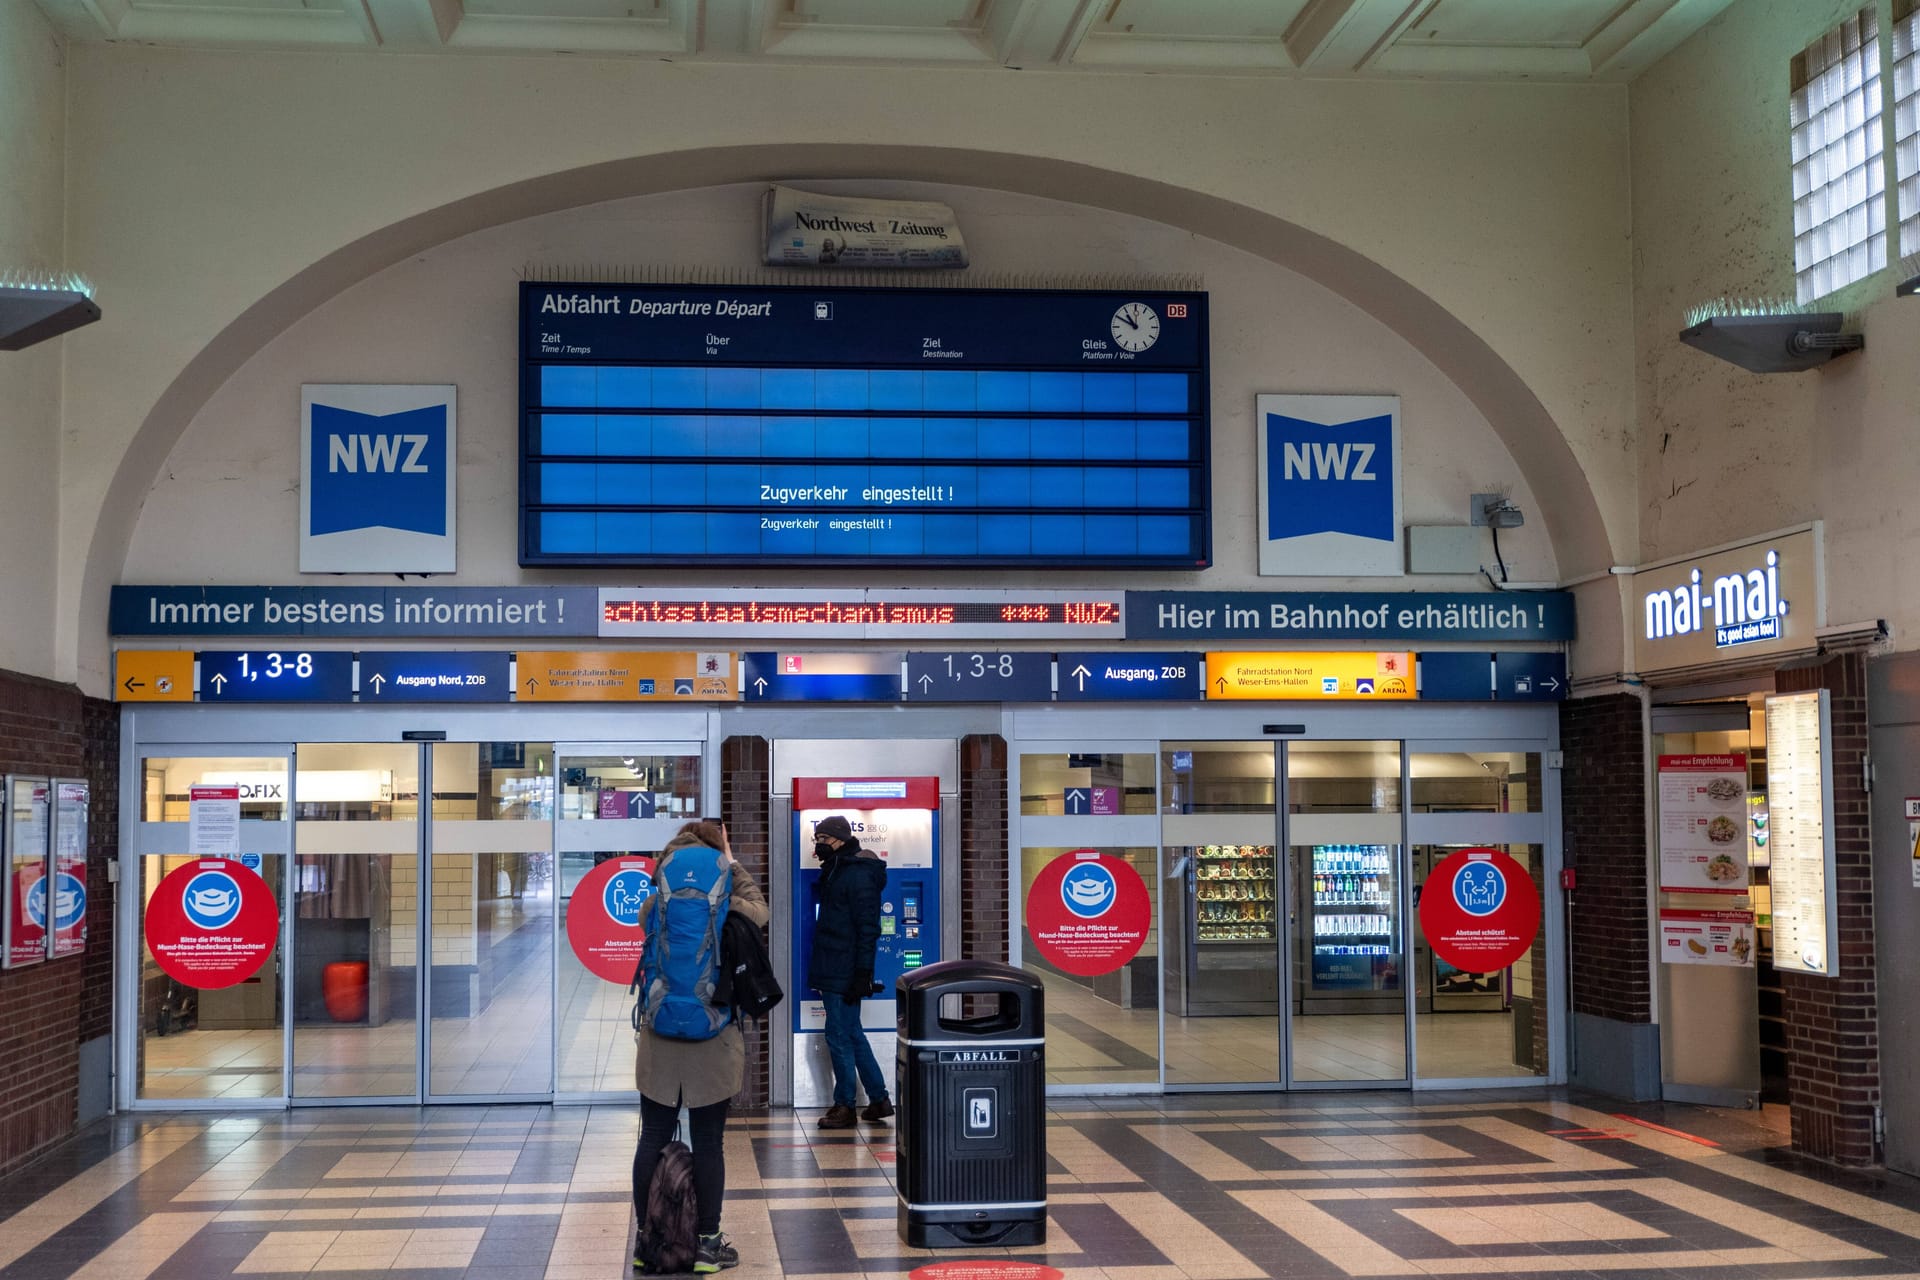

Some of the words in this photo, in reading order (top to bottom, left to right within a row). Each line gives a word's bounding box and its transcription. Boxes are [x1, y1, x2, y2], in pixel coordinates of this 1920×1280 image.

[795, 210, 877, 234] Nordwest
[888, 220, 948, 240] Zeitung
[541, 294, 621, 315] Abfahrt
[629, 298, 712, 318] Departure
[715, 300, 772, 319] Départ
[1168, 305, 1186, 317] DB
[541, 333, 561, 343] Zeit
[706, 334, 730, 346] Über
[923, 338, 941, 348] Ziel
[541, 345, 560, 353] Time
[566, 346, 591, 355] Temps
[706, 347, 718, 355] Via
[1082, 340, 1107, 350] Gleis
[923, 350, 963, 359] Destination
[1082, 352, 1113, 361] Platform
[1119, 353, 1135, 361] Voie
[329, 434, 429, 473] NWZ
[1284, 442, 1376, 481] NWZ
[760, 485, 848, 504] Zugverkehr
[862, 486, 943, 504] eingestellt
[760, 518, 819, 531] Zugverkehr
[829, 519, 885, 532] eingestellt
[150, 597, 254, 623] Immer
[264, 598, 384, 623] bestens
[394, 598, 546, 624] informiert
[1158, 604, 1215, 628] Hier
[1225, 604, 1261, 628] im
[1269, 604, 1388, 629] Bahnhof
[1397, 604, 1527, 629] erhältlich
[1727, 624, 1743, 644] good
[1743, 623, 1759, 638] asian
[1760, 620, 1775, 636] food
[237, 654, 258, 682] 1,
[265, 654, 313, 678] 3-8
[943, 656, 961, 680] 1,
[970, 655, 1013, 677] 3-8
[1105, 667, 1157, 680] Ausgang,
[1161, 667, 1186, 678] ZOB
[1237, 668, 1290, 676] Fahrradstation
[1294, 668, 1313, 676] Nord
[396, 675, 436, 686] Ausgang
[437, 674, 464, 686] Nord,
[466, 674, 486, 684] ZOB
[1692, 757, 1734, 766] Empfehlung
[574, 769, 584, 783] 3
[953, 1052, 1007, 1061] ABFALL
